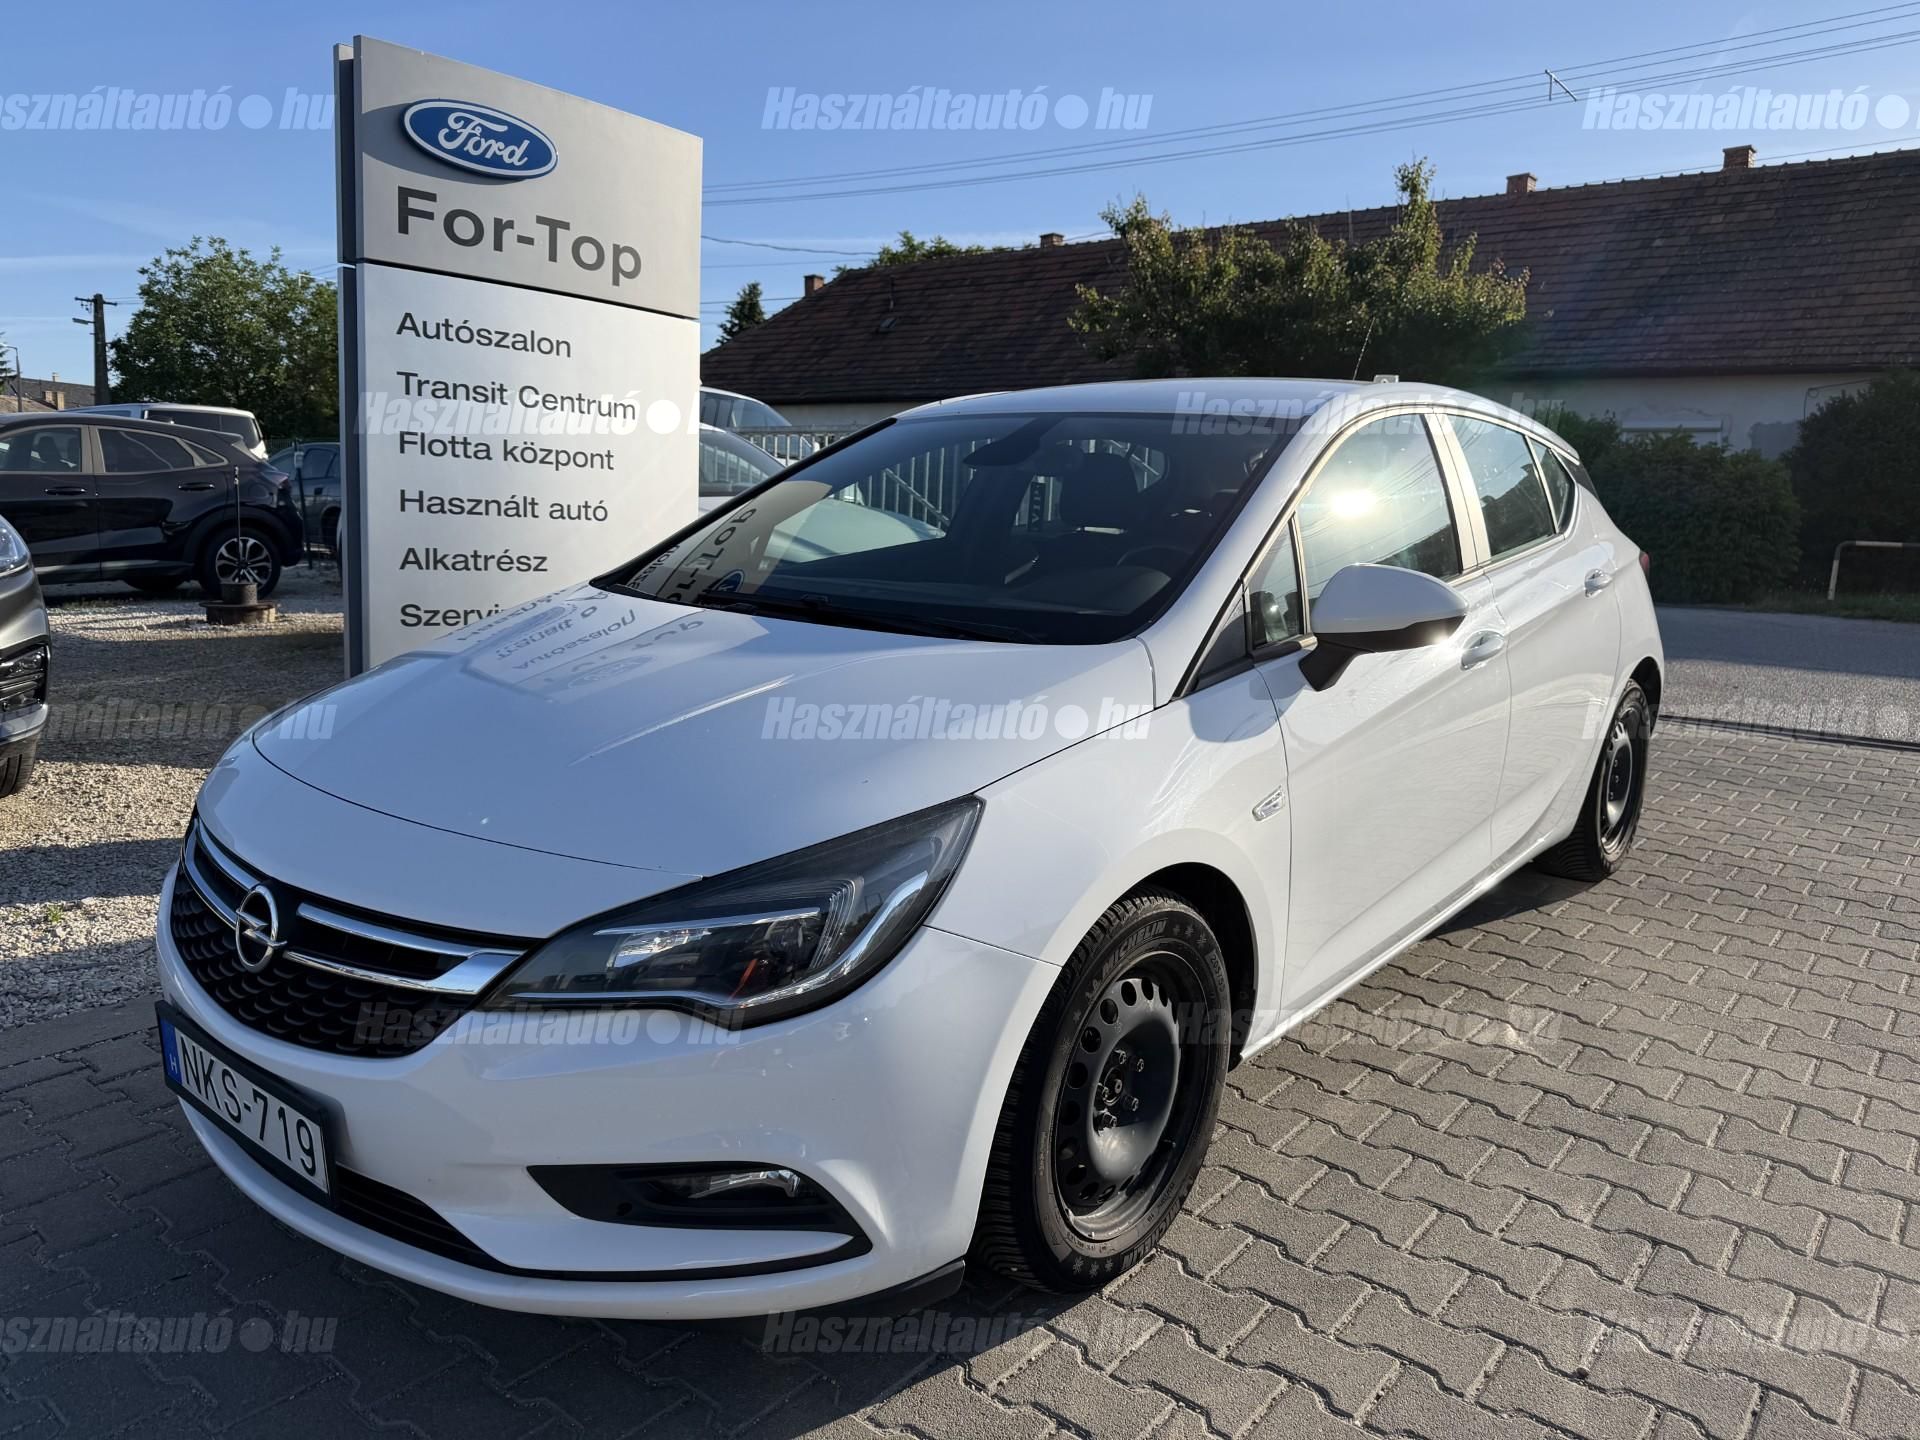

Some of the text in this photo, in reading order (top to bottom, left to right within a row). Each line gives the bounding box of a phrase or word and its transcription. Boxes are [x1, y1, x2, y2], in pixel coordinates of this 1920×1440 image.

[438, 111, 529, 167] Ford
[397, 186, 642, 286] For-Top
[396, 312, 572, 358] Autószalon
[396, 371, 636, 420] Transit Centrum
[399, 431, 615, 472] Flotta központ
[399, 489, 608, 522] Használt autó
[399, 547, 549, 573] Alkatrész
[400, 603, 504, 628] Szerv
[169, 1053, 178, 1075] H
[180, 1034, 317, 1178] NKS-719
